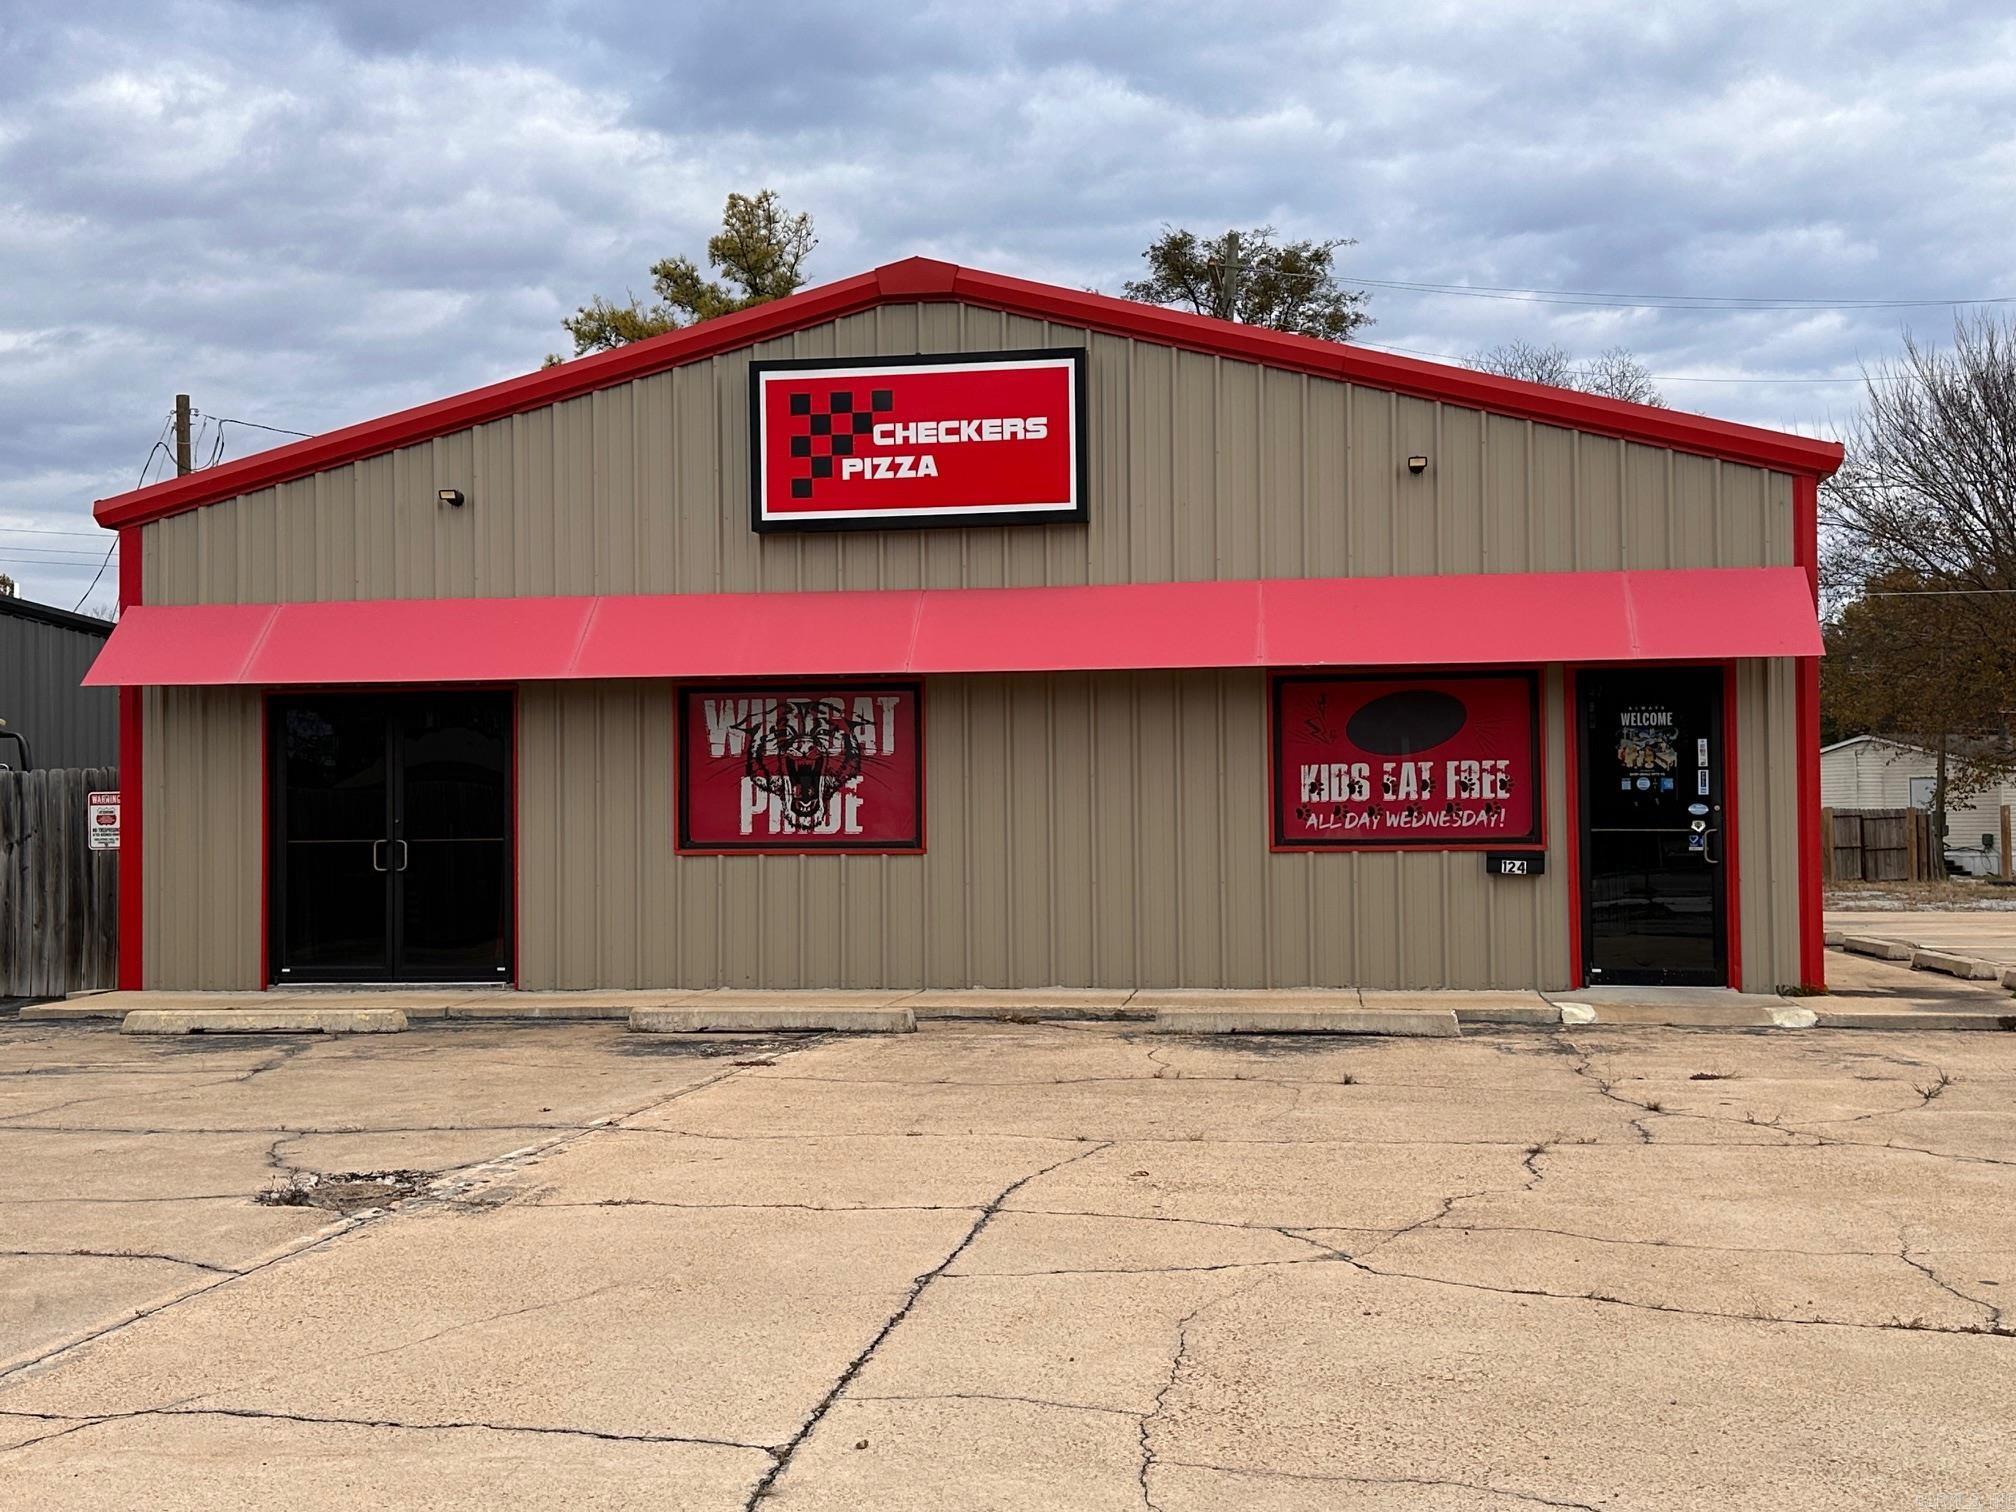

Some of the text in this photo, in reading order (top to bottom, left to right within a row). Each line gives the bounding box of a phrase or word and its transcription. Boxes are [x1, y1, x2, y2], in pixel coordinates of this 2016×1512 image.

[873, 416, 1048, 446] CHECKERS
[842, 455, 939, 480] PIZZA
[1620, 712, 1673, 726] WELCOME
[1300, 760, 1511, 803] KIDS EAT FREE
[739, 776, 864, 835] PRDE
[1305, 808, 1506, 830] ALL DAY WEDNESDAY!
[1502, 861, 1526, 873] 124
